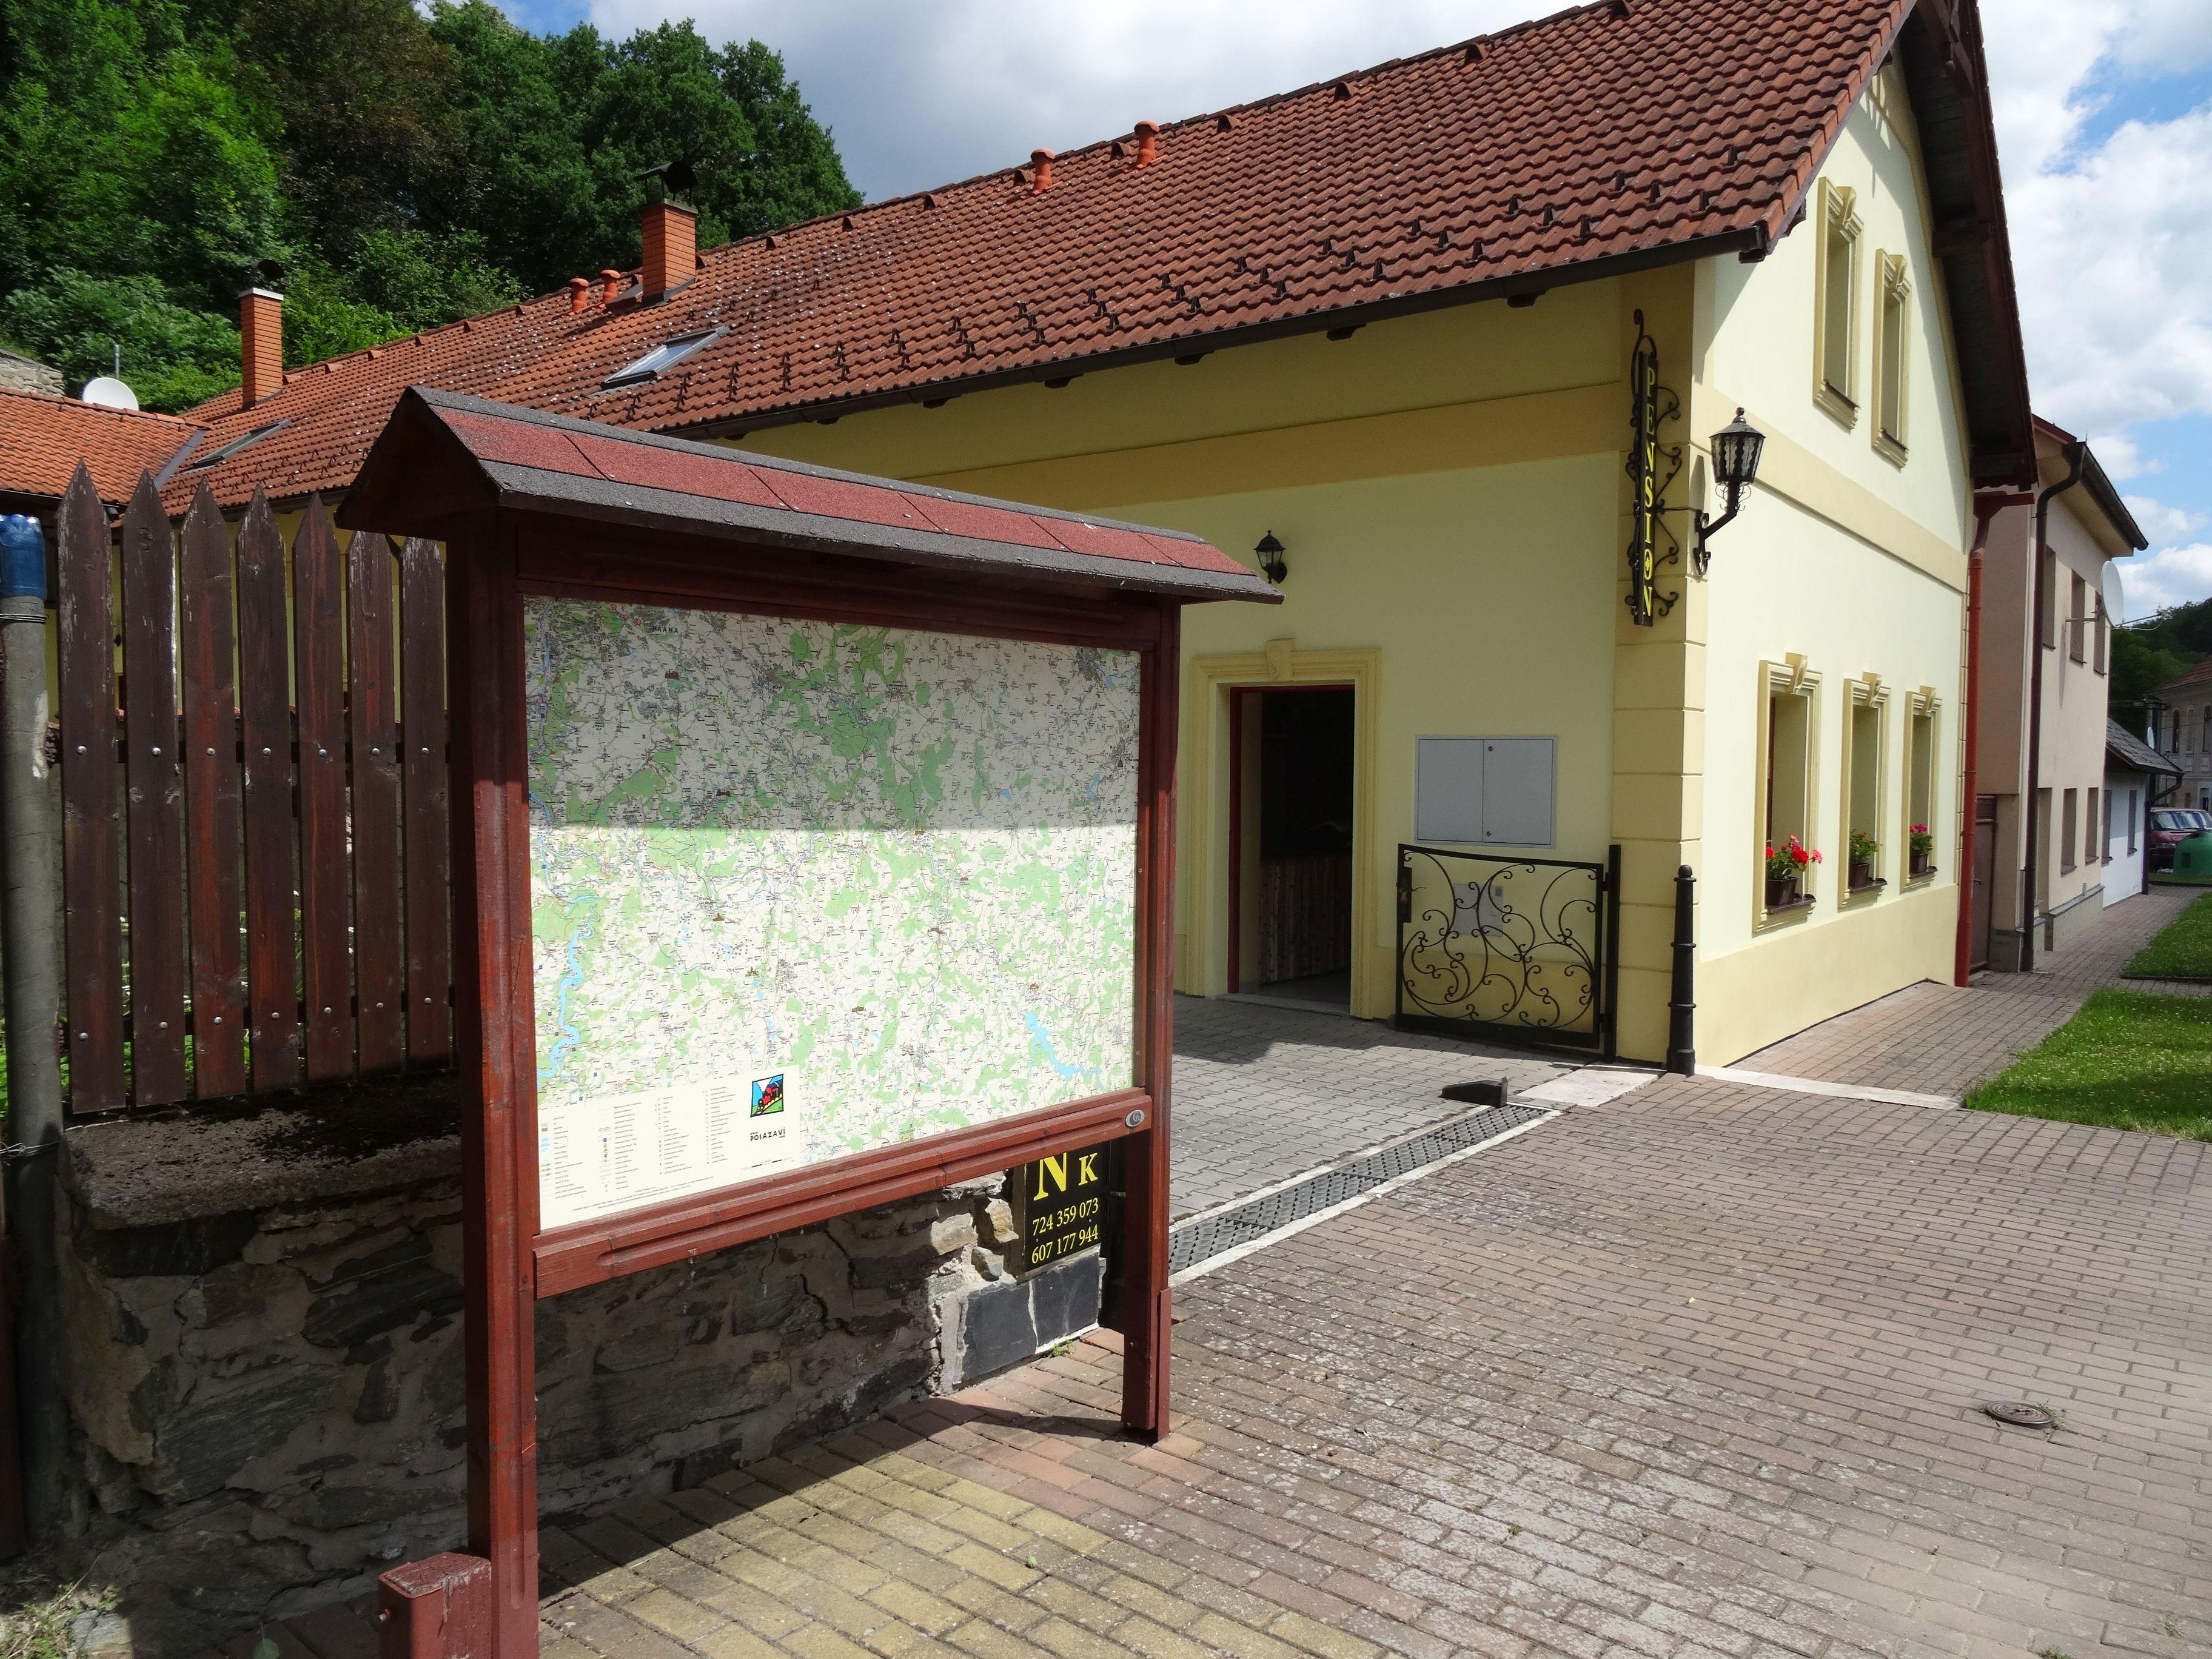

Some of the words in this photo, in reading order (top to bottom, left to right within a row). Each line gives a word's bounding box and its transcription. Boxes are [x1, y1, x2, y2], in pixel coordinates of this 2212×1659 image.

[1643, 367, 1655, 617] PENSION
[652, 625, 679, 634] PRAHA
[1033, 1214, 1053, 1236] 724
[1056, 1205, 1076, 1227] 359
[1079, 1198, 1099, 1218] 073
[1031, 1241, 1053, 1264] 607
[1056, 1232, 1076, 1255] 177
[1079, 1224, 1099, 1245] 944
